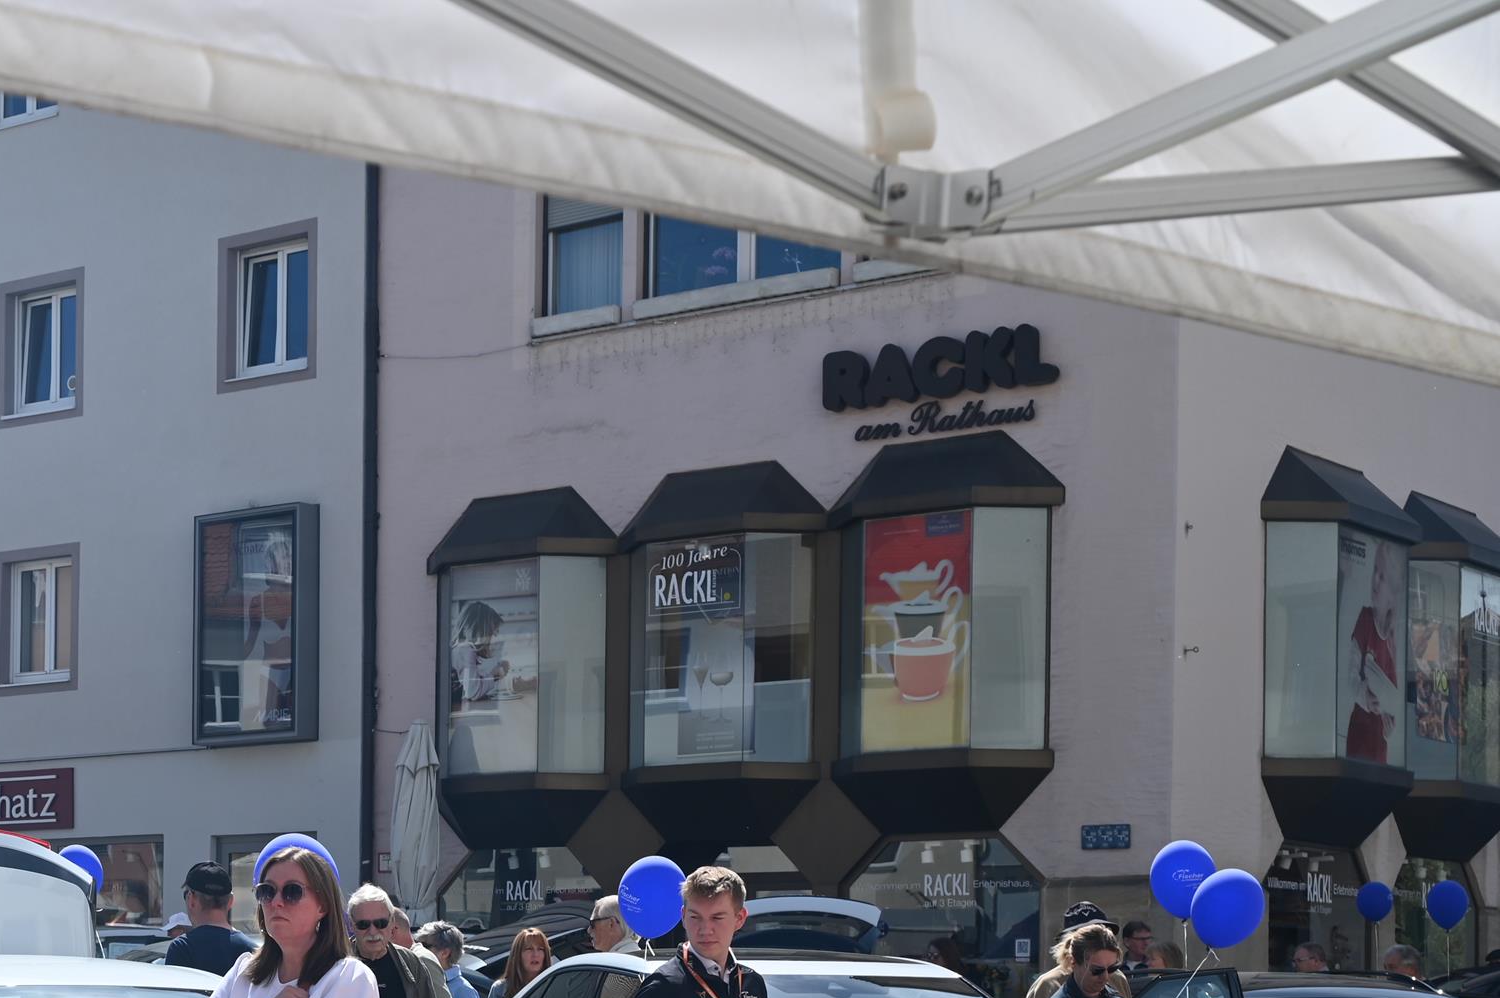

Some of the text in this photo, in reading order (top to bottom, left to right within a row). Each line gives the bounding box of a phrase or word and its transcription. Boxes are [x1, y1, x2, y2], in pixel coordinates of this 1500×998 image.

[822, 323, 1060, 412] RACKL
[854, 399, 1036, 441] am Rathaus
[660, 546, 729, 571] 100 Jahre
[655, 569, 717, 607] RACKL
[506, 880, 544, 902] RACKL
[923, 873, 971, 897] RACKL
[1307, 872, 1333, 904] RACKL
[1333, 883, 1360, 897] Erlebnisha
